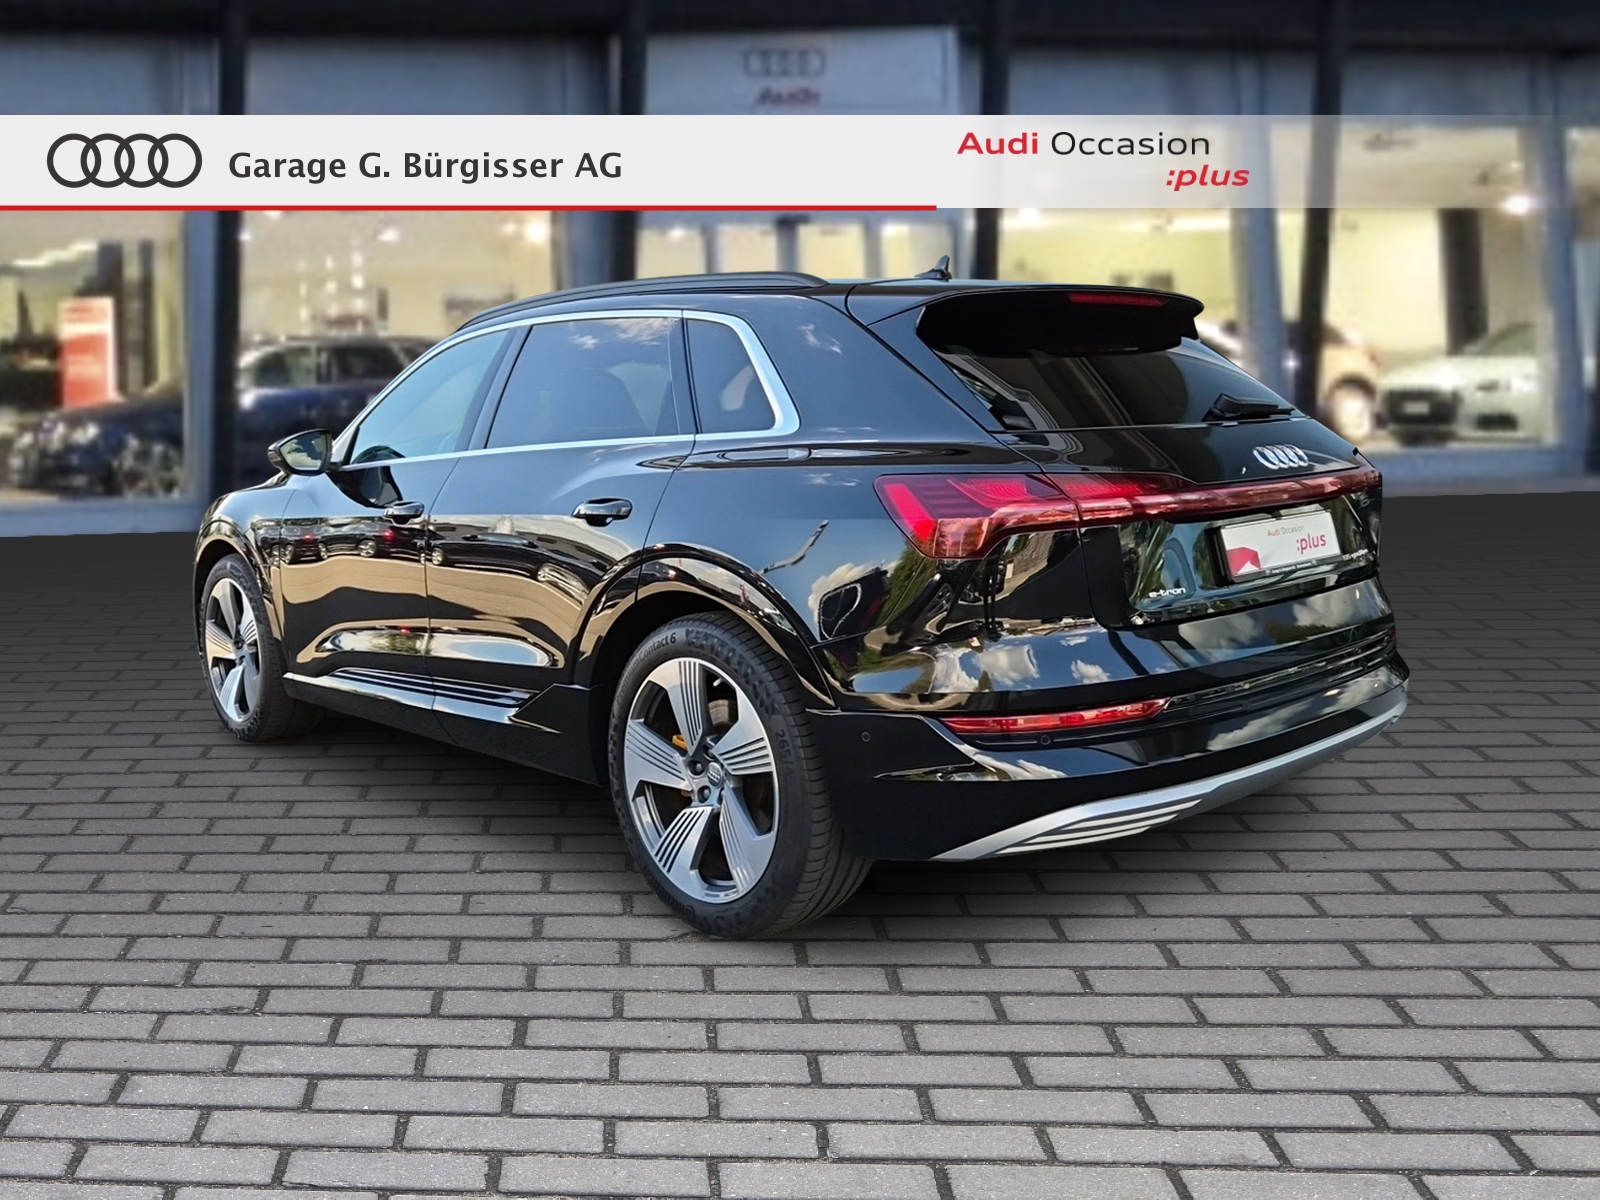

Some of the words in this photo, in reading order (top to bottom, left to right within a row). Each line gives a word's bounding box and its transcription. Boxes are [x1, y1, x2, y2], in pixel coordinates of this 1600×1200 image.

[1267, 527, 1281, 537] Audi
[1296, 533, 1327, 554] :plus
[1148, 587, 1187, 598] e-tron
